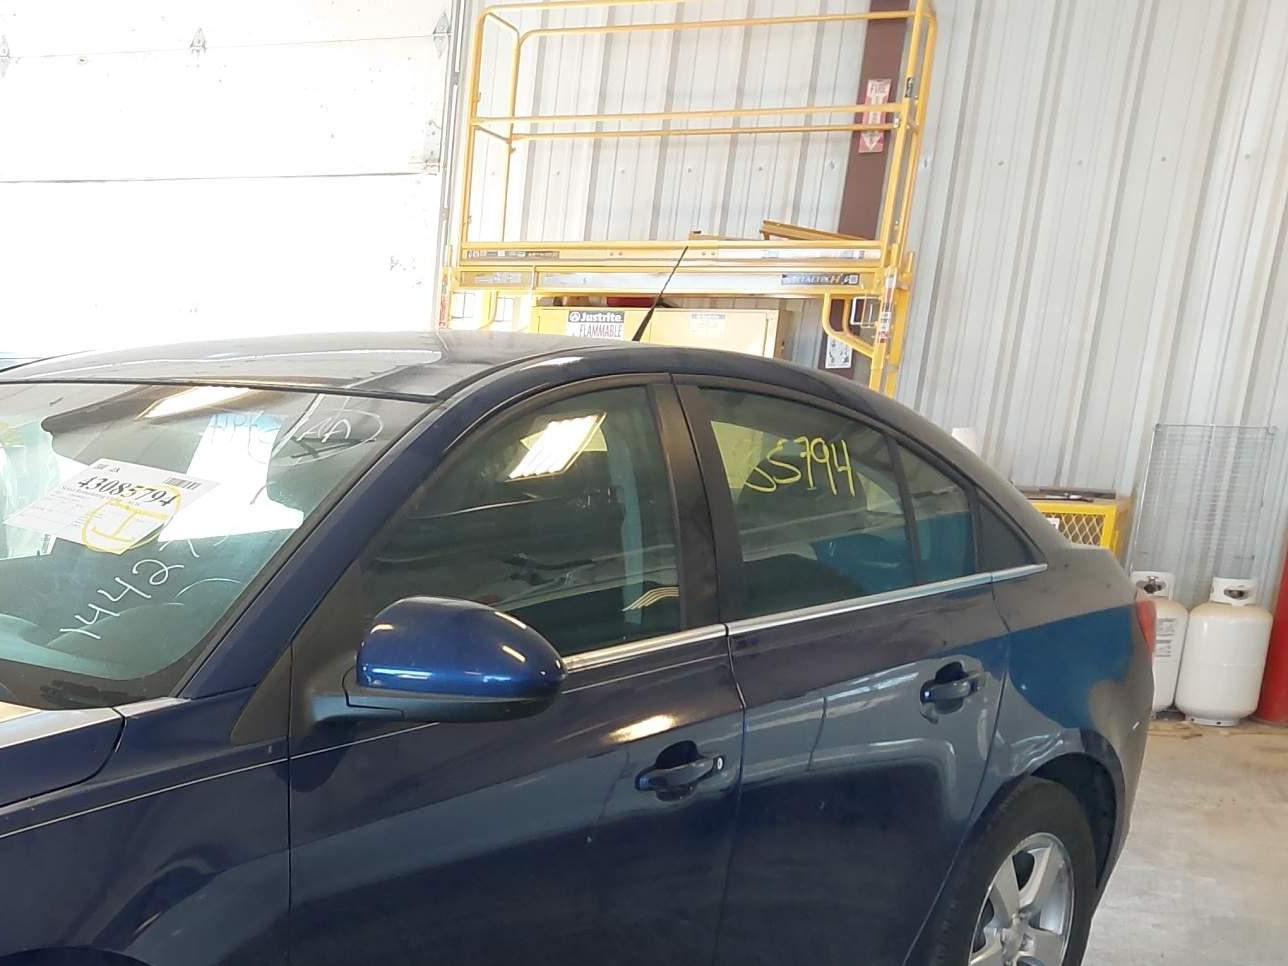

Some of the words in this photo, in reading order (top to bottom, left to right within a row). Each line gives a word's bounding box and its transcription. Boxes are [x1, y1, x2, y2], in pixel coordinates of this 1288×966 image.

[580, 312, 622, 322] Justrite
[579, 323, 623, 338] FLAMMABLE
[77, 476, 180, 508] 43085794
